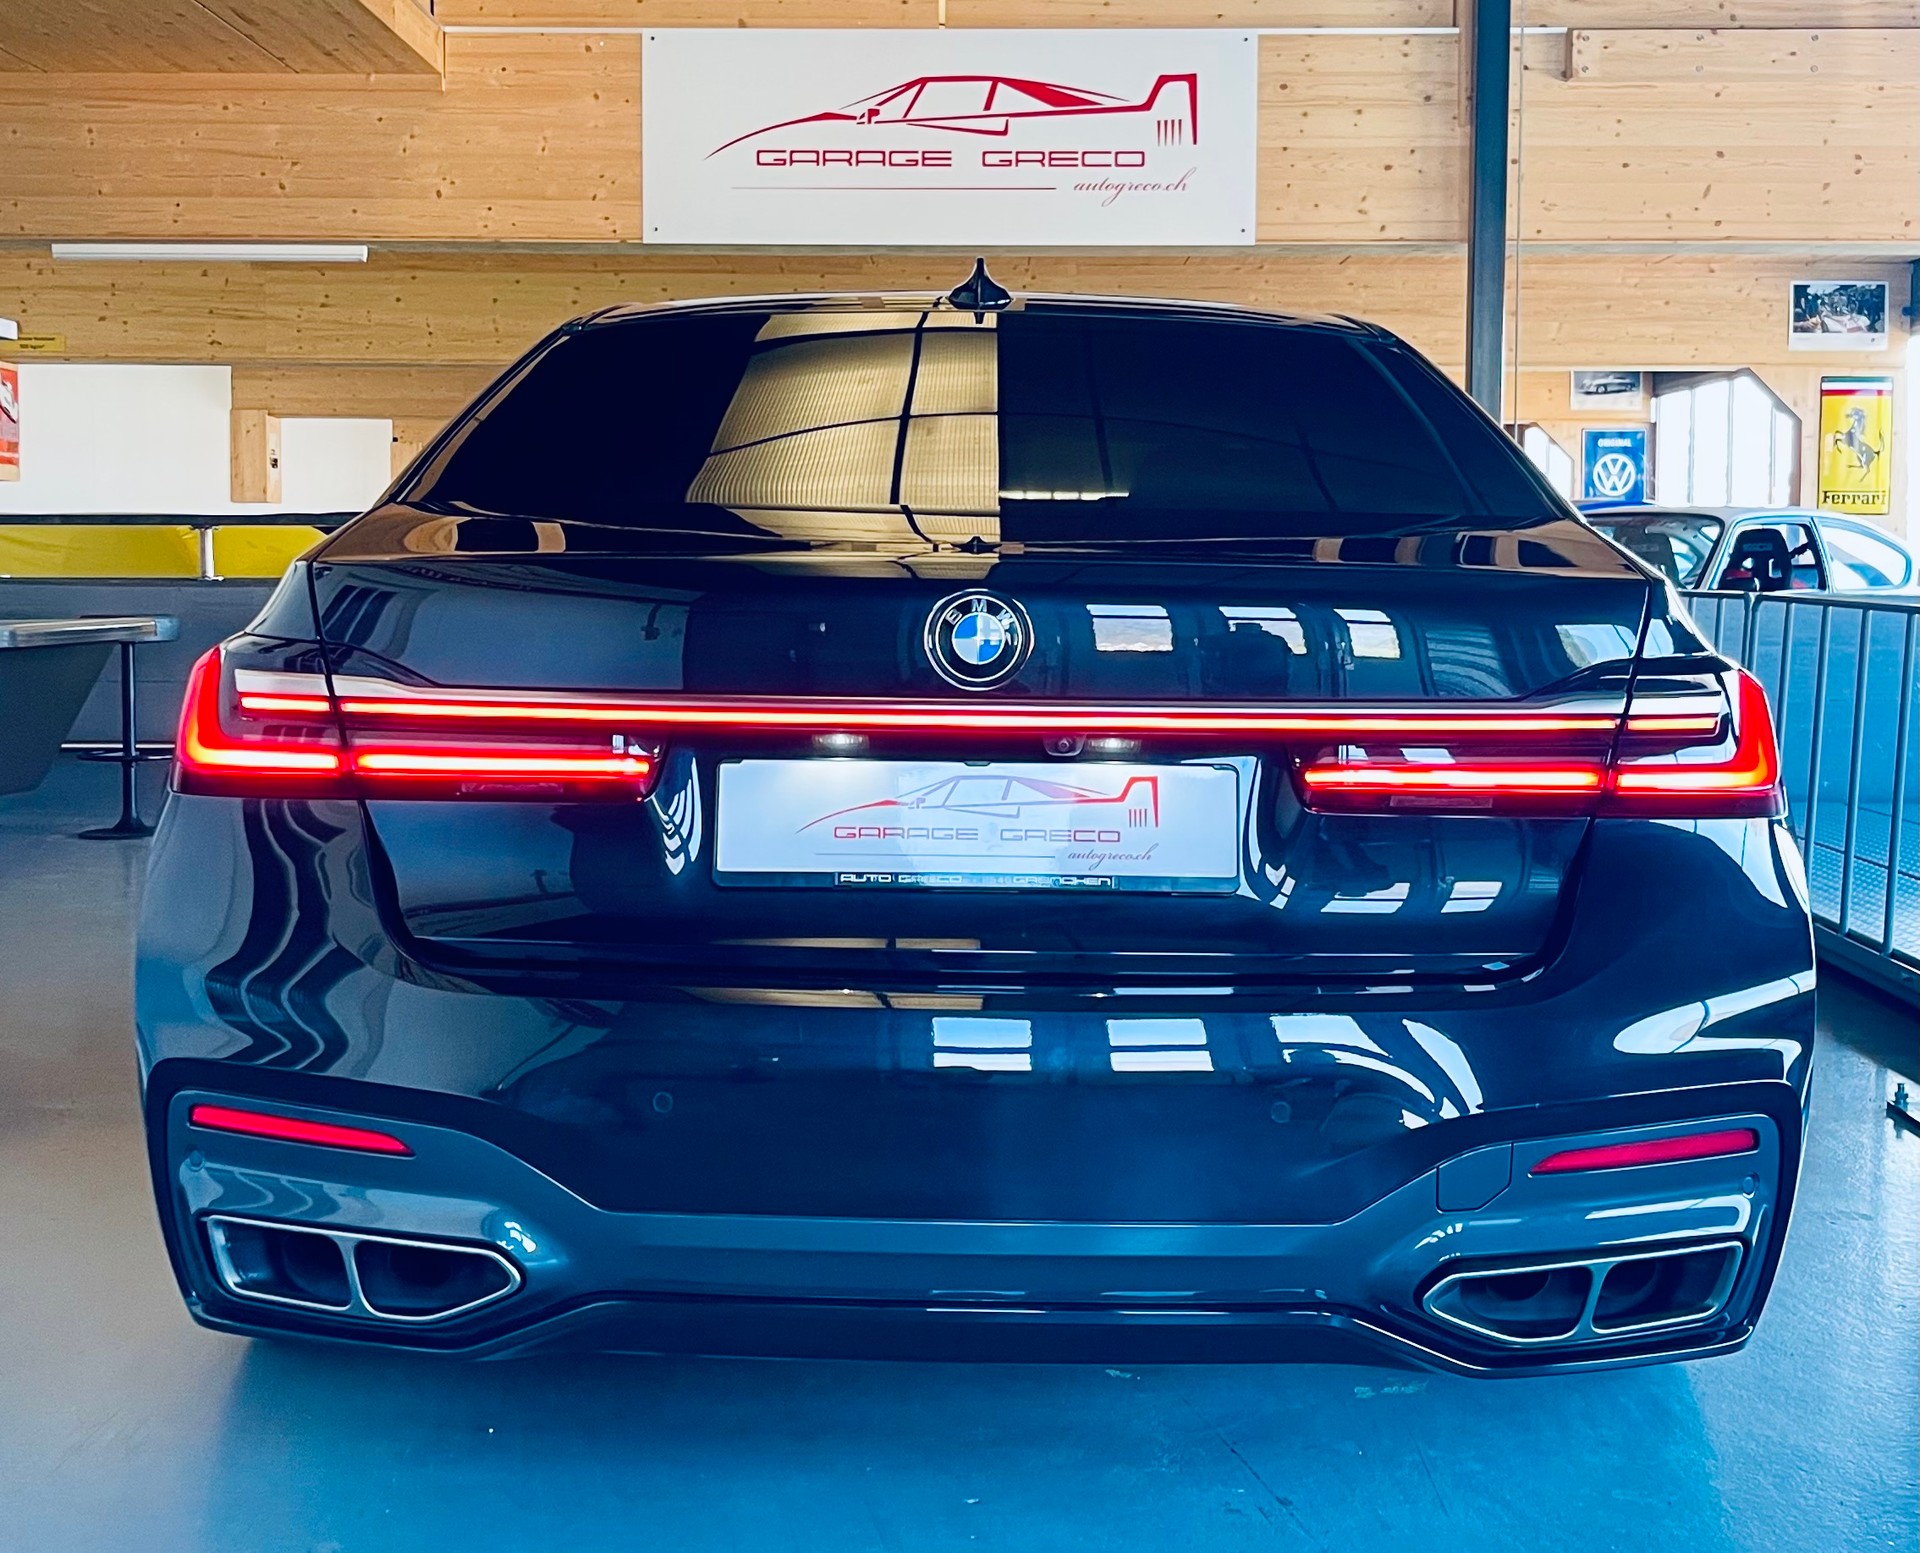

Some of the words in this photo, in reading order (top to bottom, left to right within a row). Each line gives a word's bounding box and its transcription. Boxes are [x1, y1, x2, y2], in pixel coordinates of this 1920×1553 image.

[756, 149, 952, 167] GARAGE
[982, 150, 1145, 168] GRECO
[1073, 166, 1197, 207] autogreco.ch
[1822, 490, 1886, 505] Ferrari
[945, 599, 1014, 627] BMW
[834, 826, 978, 841] GARAGE
[1000, 828, 1121, 843] GRECO
[840, 874, 891, 882] AUTO
